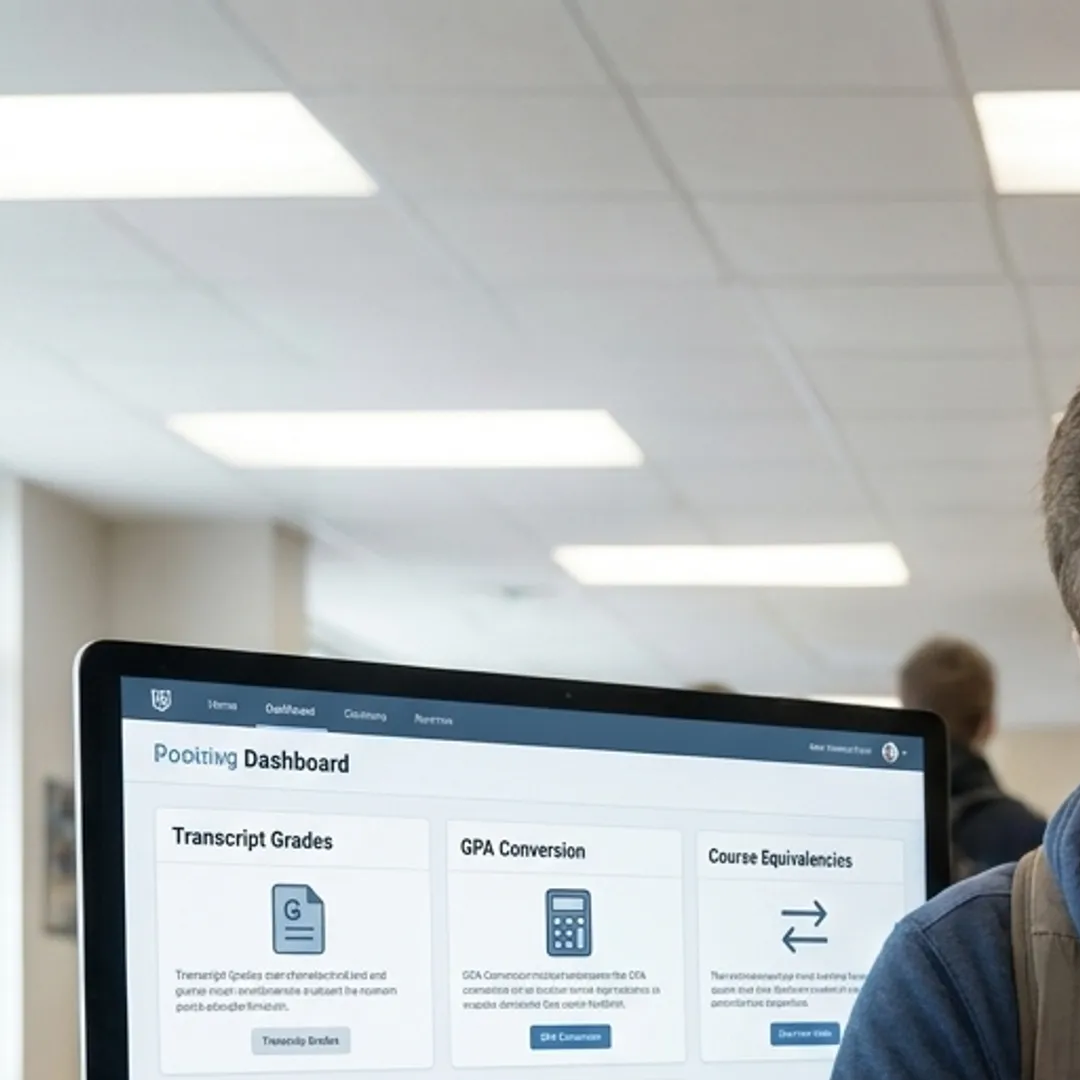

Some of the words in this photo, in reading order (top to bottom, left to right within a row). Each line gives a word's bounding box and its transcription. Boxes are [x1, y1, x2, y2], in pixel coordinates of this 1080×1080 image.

[244, 749, 350, 774] Dashboard
[172, 826, 266, 851] Transcript
[271, 830, 333, 851] Grades
[460, 837, 494, 856] GPA
[499, 839, 586, 860] Conversion
[709, 847, 758, 866] Course
[761, 849, 854, 869] Equivalencies
